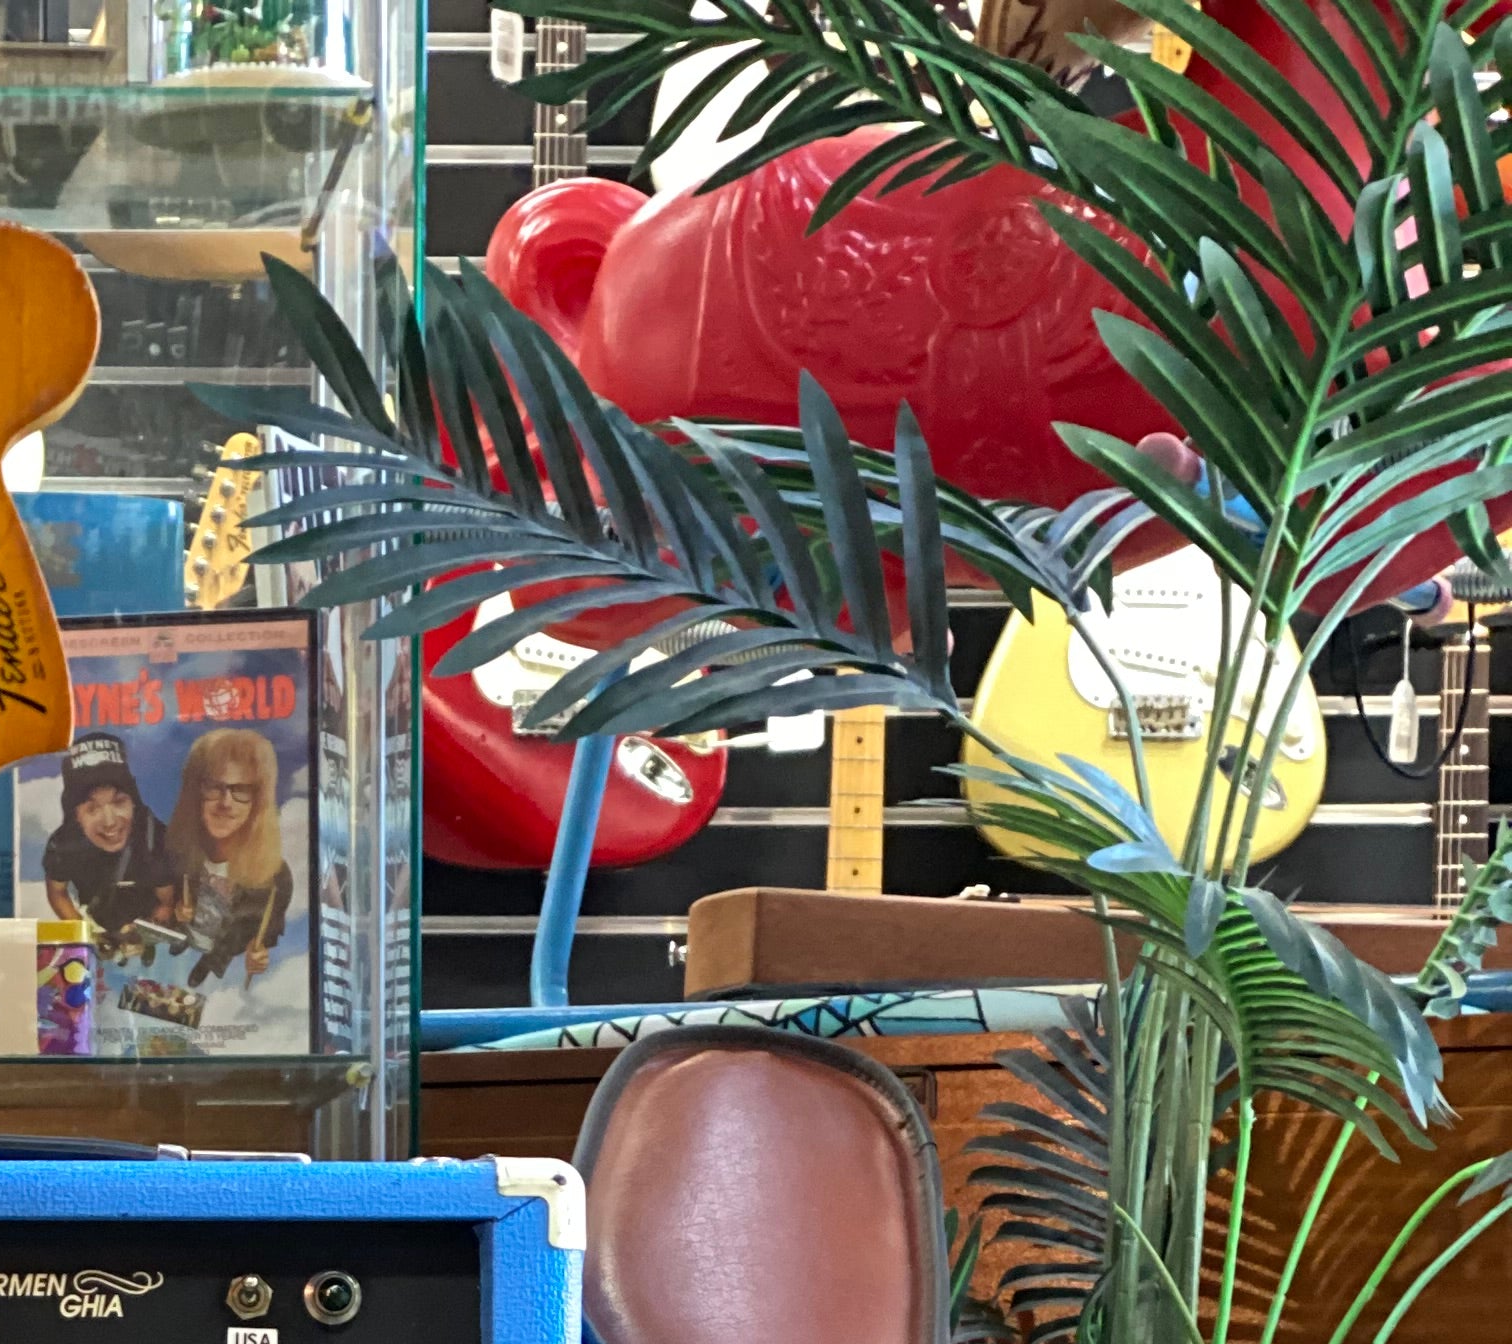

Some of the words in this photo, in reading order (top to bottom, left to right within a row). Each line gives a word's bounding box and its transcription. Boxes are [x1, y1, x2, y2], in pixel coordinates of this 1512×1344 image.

[185, 629, 285, 643] COLLECTION
[73, 667, 165, 728] YNE'S
[59, 1294, 124, 1318] GHIA
